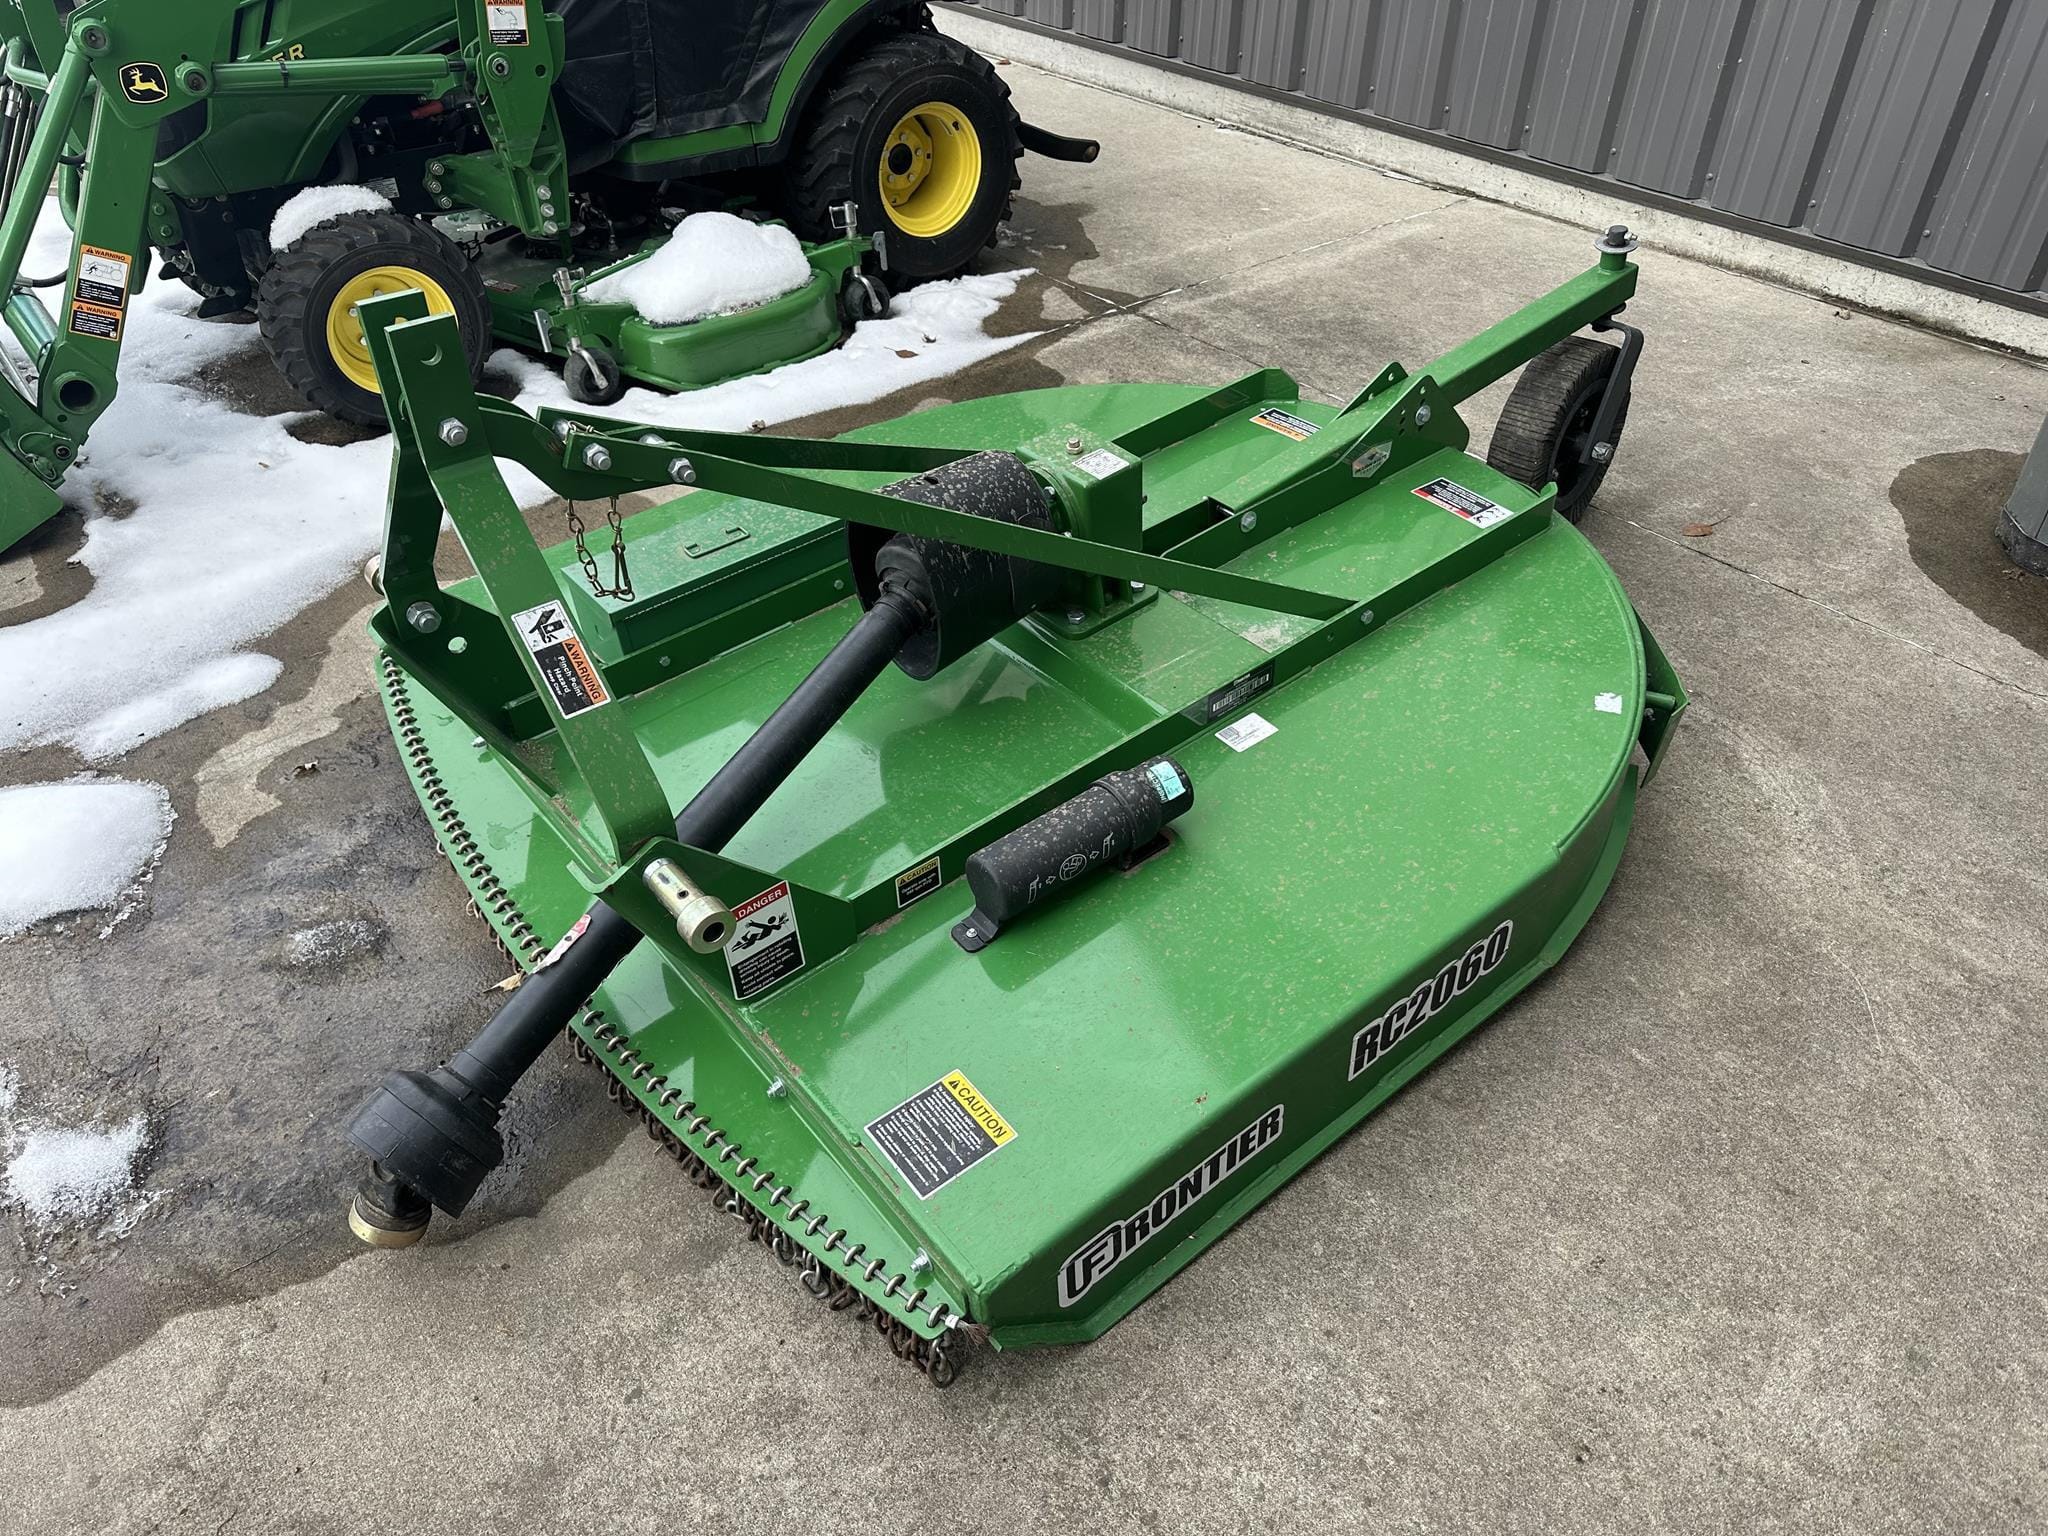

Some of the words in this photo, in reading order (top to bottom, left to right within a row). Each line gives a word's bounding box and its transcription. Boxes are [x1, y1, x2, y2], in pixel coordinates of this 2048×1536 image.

[94, 249, 126, 261] WARNING
[86, 305, 117, 317] WARNING
[553, 667, 572, 694] Hazard
[557, 655, 573, 677] Pinch
[569, 676, 584, 697] Point
[571, 650, 601, 700] WARNING
[738, 889, 783, 918] DANGER
[1352, 925, 1510, 1076] RC2060
[957, 1087, 1007, 1139] CAUTION
[1066, 1107, 1281, 1300] FRONTIER
